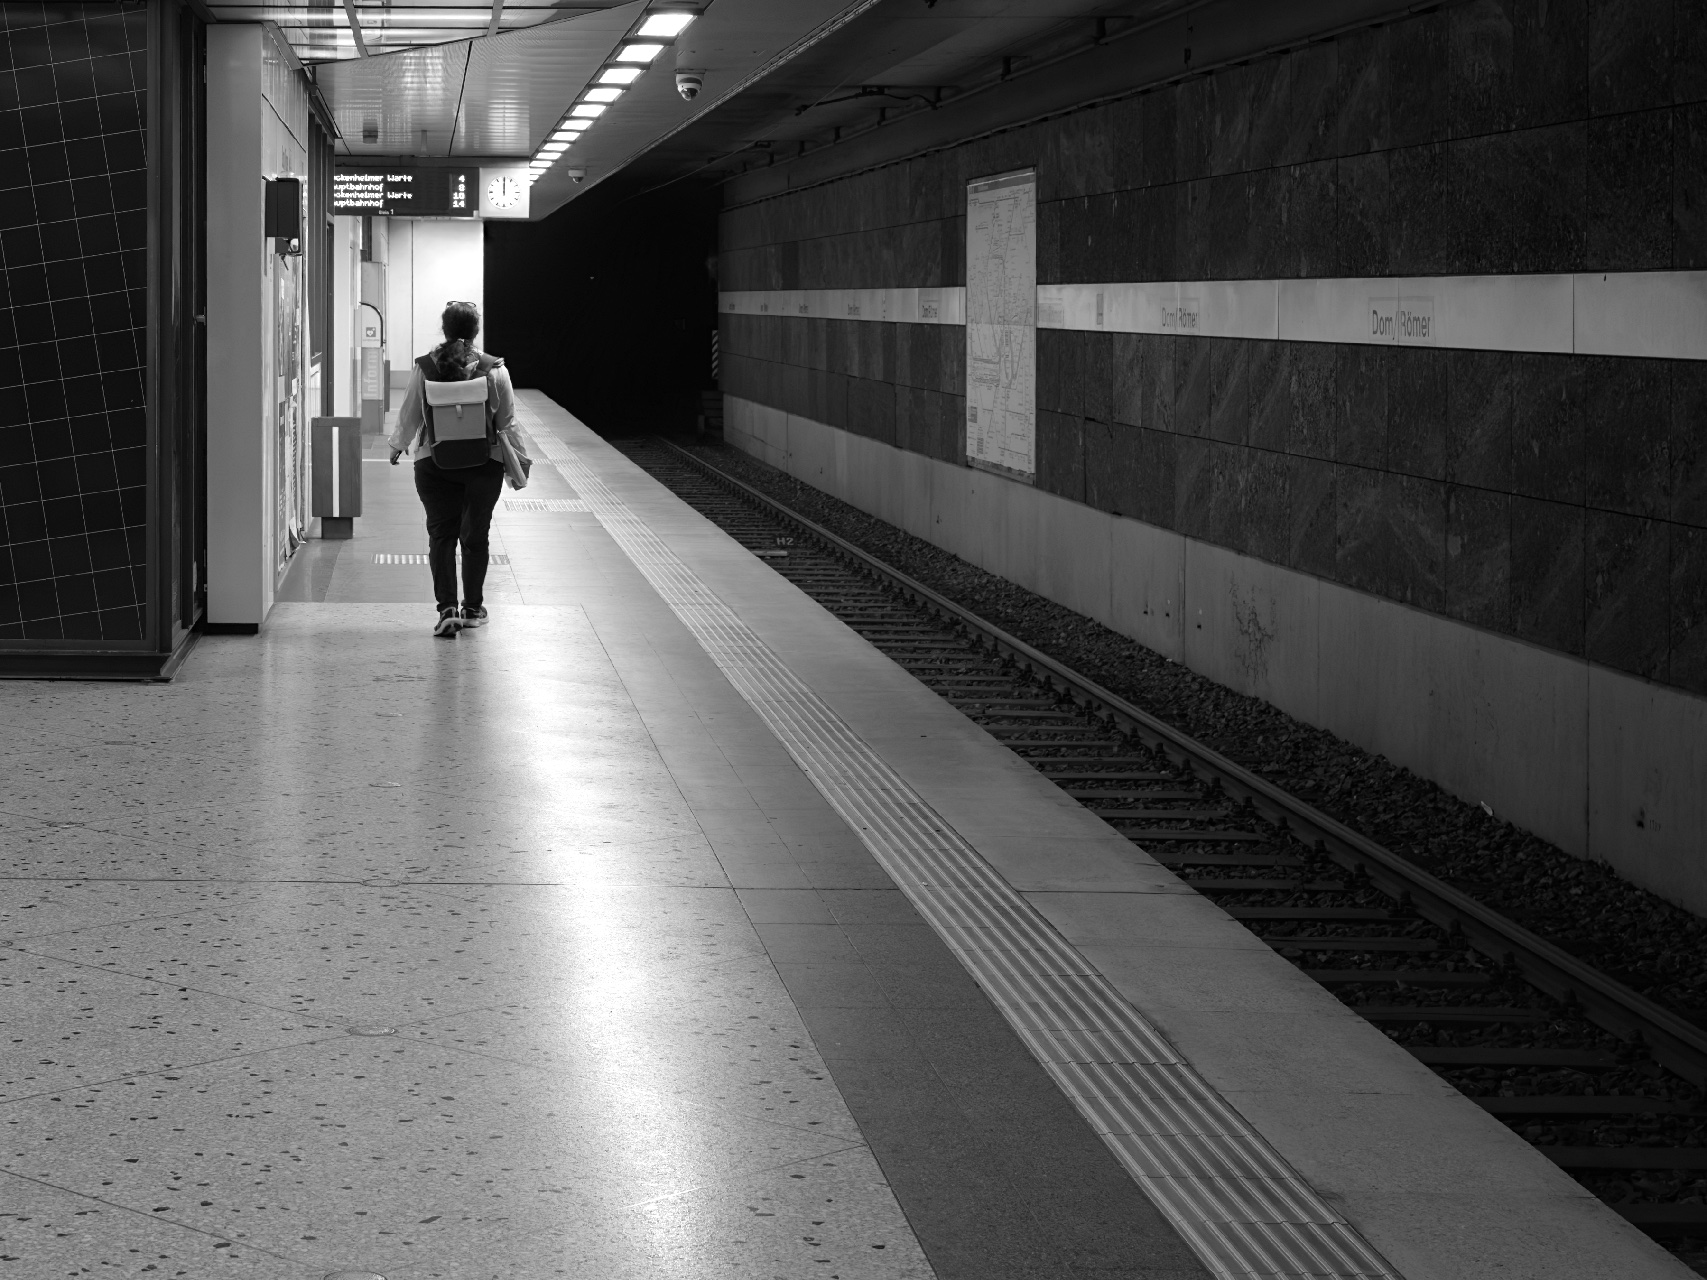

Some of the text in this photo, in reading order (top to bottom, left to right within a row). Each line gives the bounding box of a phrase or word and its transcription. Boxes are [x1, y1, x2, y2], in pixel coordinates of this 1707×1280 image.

[387, 174, 413, 182] Warte
[387, 191, 413, 199] Warte
[1372, 309, 1431, 340] Dom/Römer
